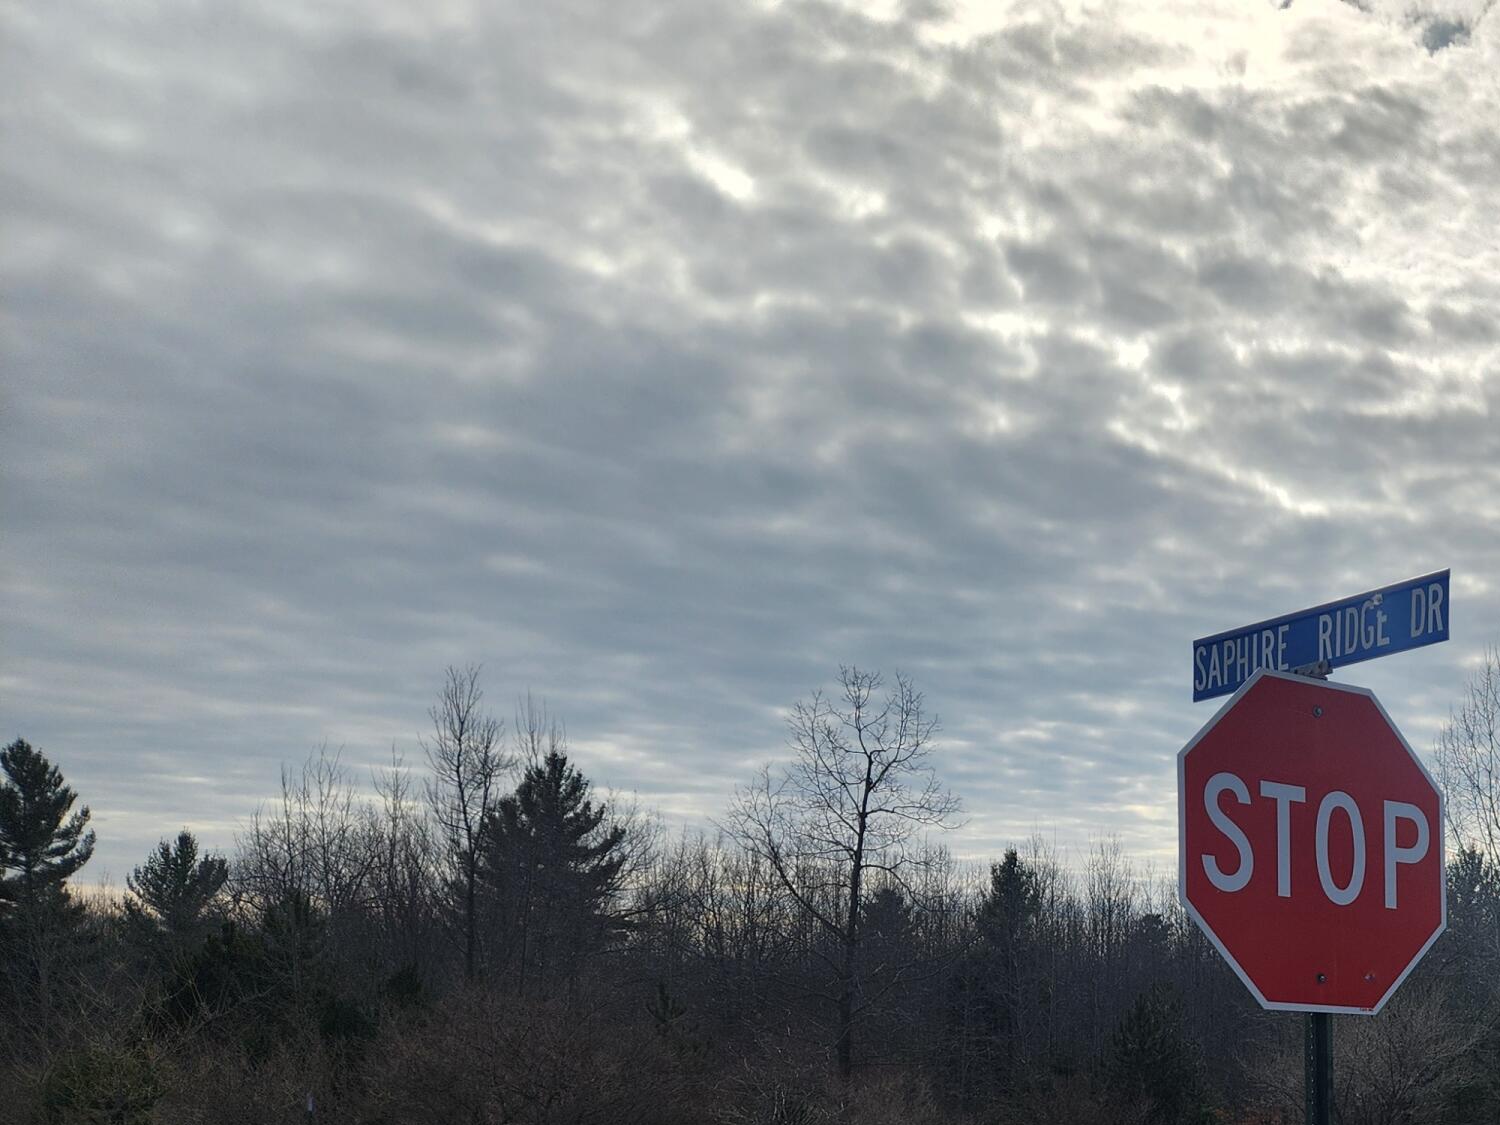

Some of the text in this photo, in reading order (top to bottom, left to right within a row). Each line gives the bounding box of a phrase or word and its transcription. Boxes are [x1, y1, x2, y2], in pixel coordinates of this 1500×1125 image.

[1194, 583, 1444, 692] SAPHIRE RIDGE DR
[1201, 772, 1430, 909] STOP
